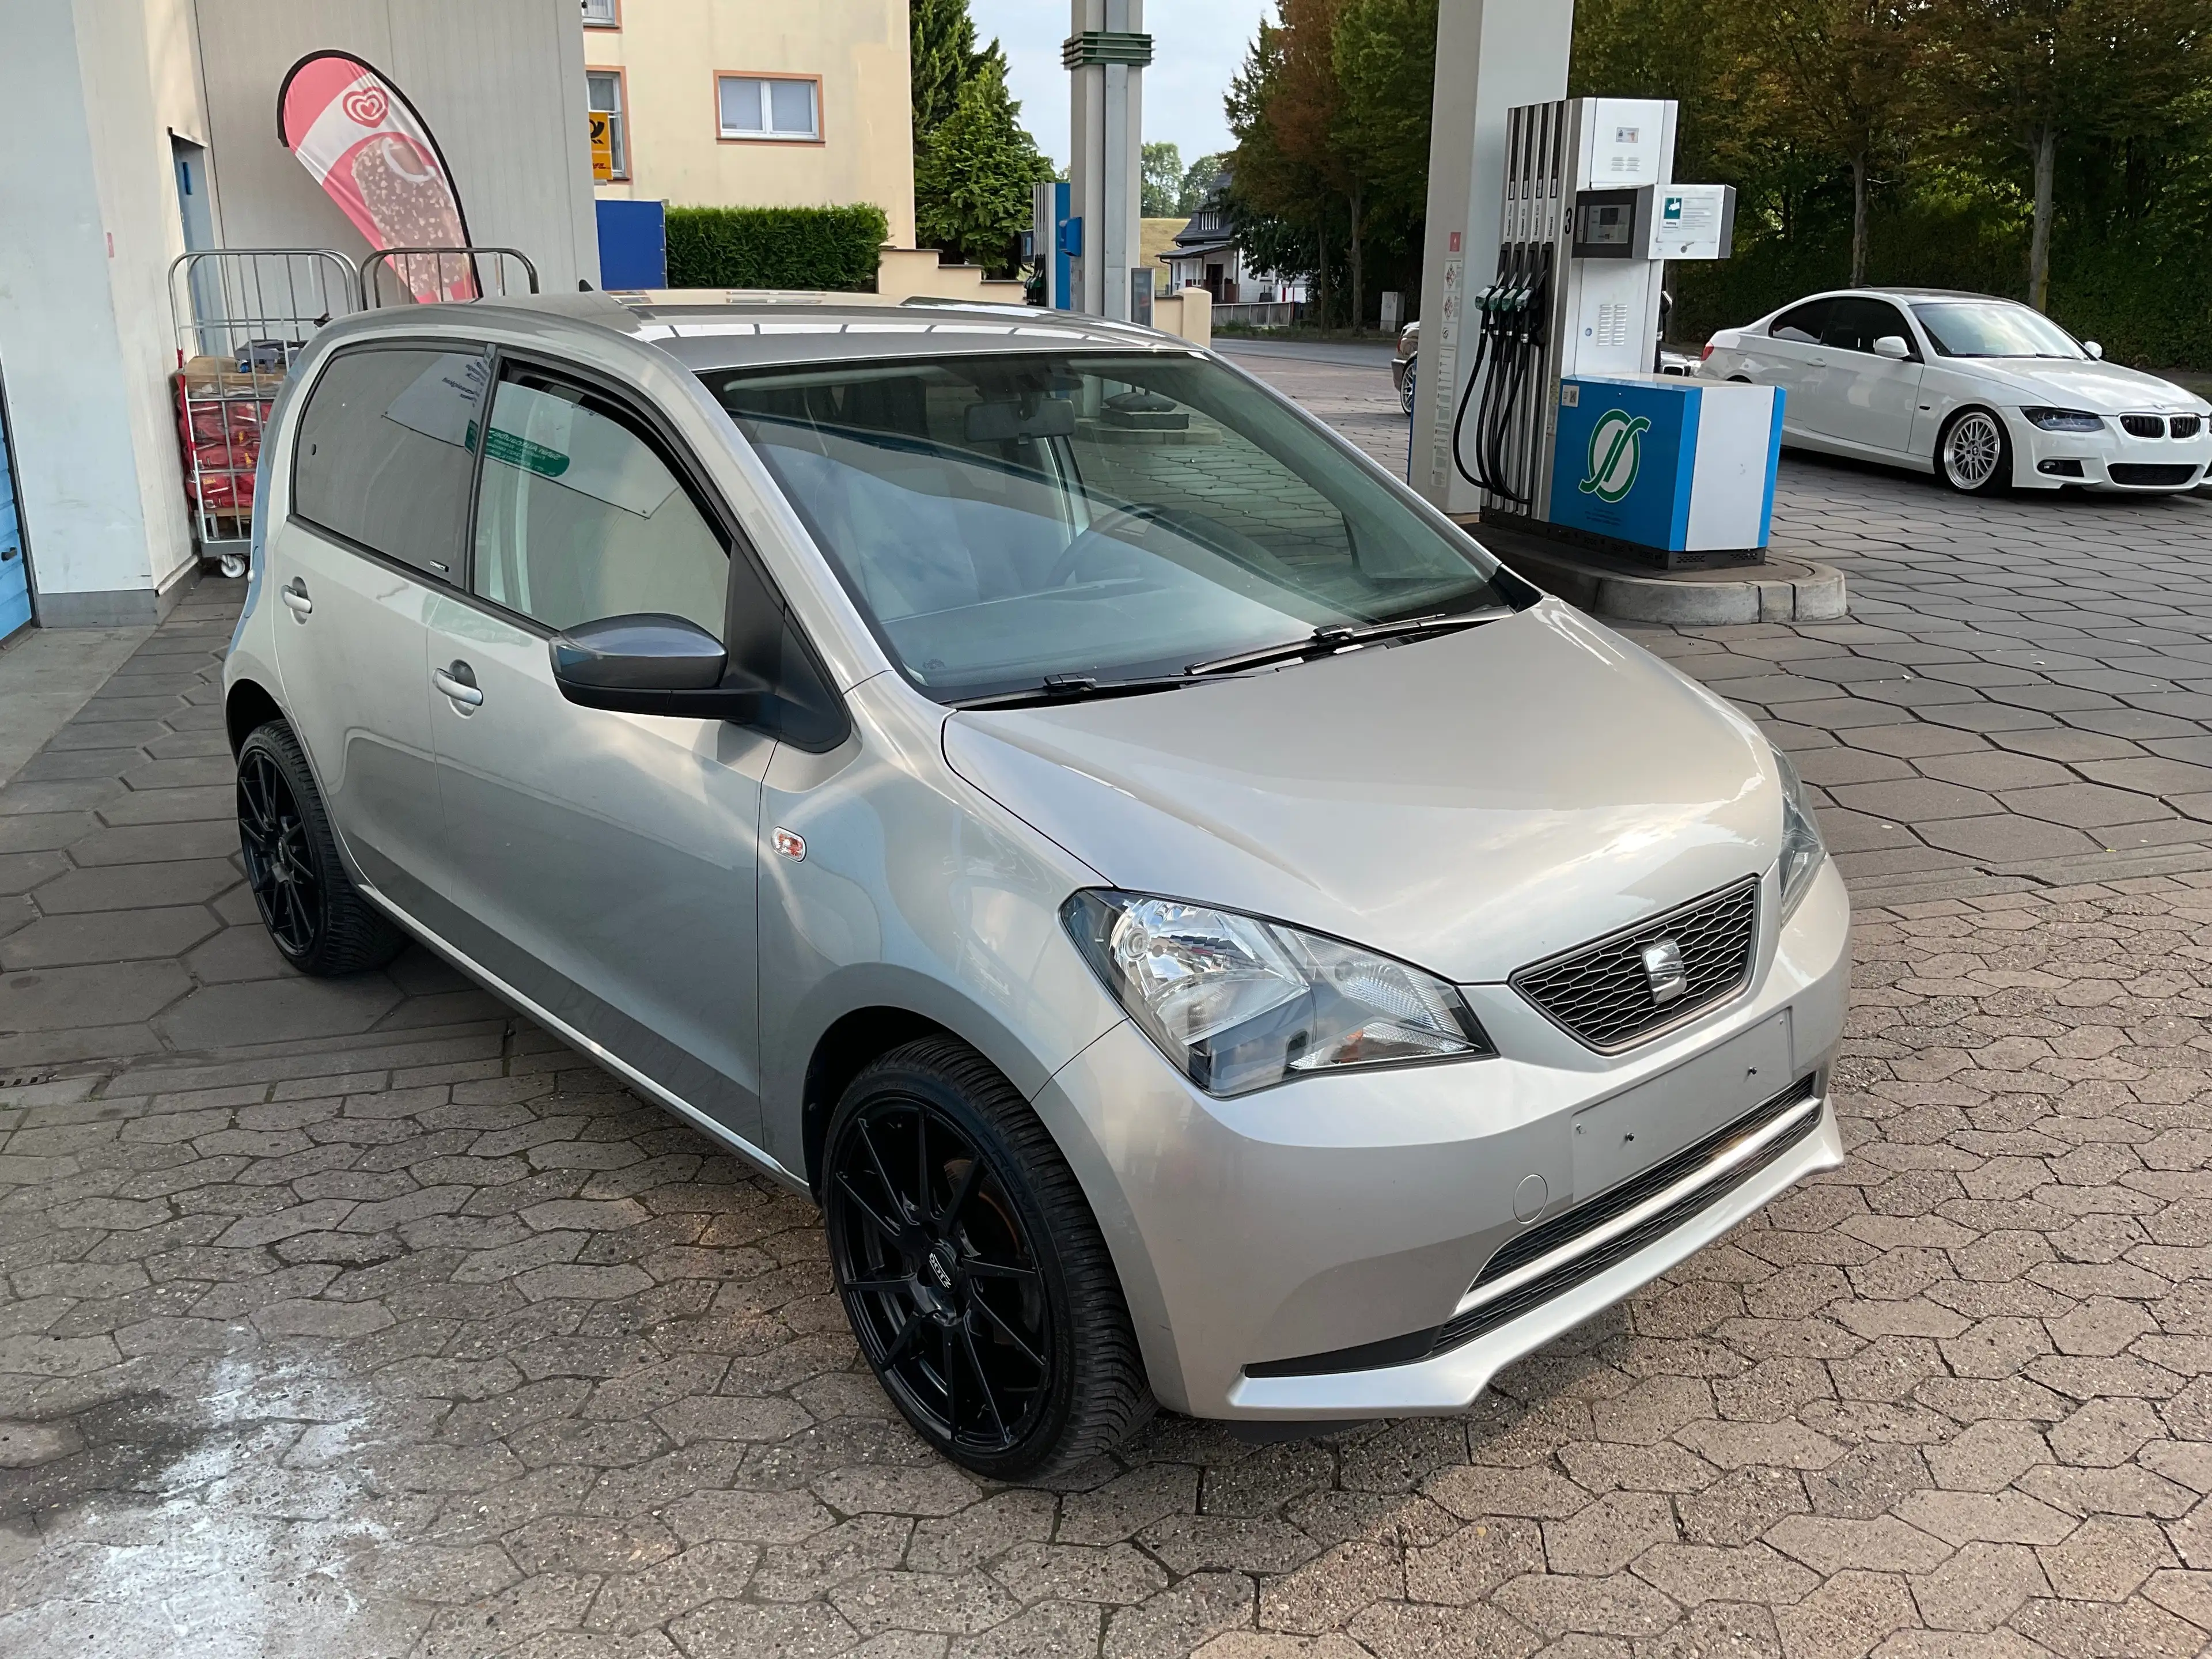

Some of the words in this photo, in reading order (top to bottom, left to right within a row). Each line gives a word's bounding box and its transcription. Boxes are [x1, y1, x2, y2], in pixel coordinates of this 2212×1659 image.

[1565, 207, 1573, 234] 3
[929, 1252, 951, 1289] DOTZ
[1062, 1327, 1070, 1384] SEASON
